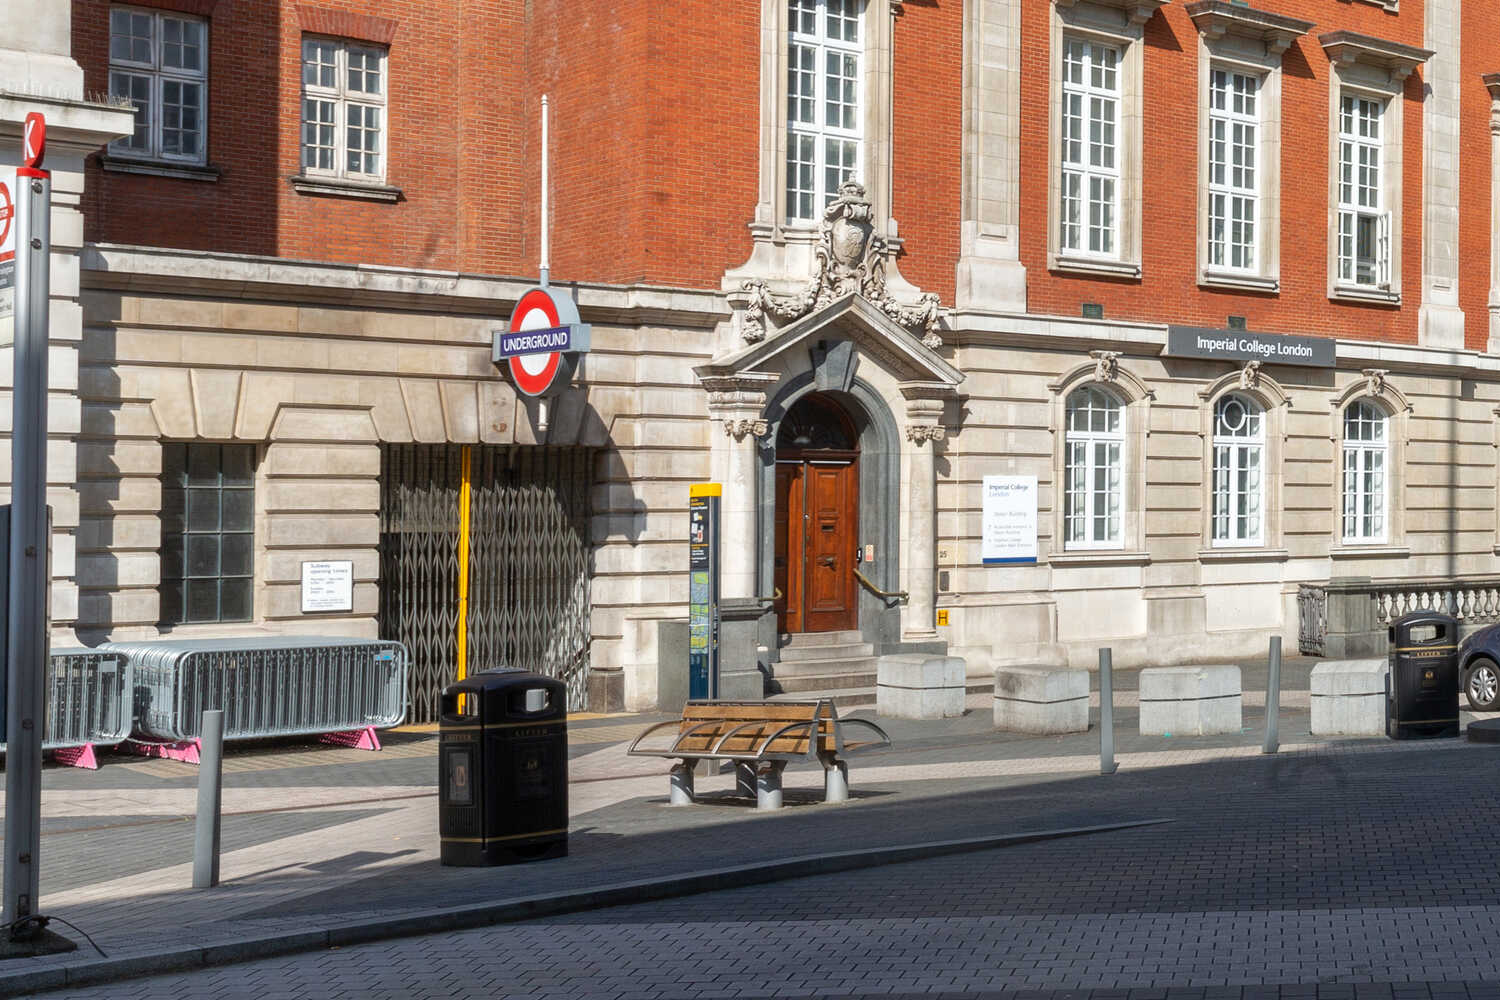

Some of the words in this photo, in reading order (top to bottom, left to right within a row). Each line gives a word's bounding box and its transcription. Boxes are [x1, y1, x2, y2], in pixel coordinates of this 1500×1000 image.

[24, 120, 36, 161] K
[503, 332, 568, 352] UNDERGROUND
[1197, 336, 1237, 353] Imperial
[1239, 339, 1276, 357] College
[1277, 342, 1313, 357] London
